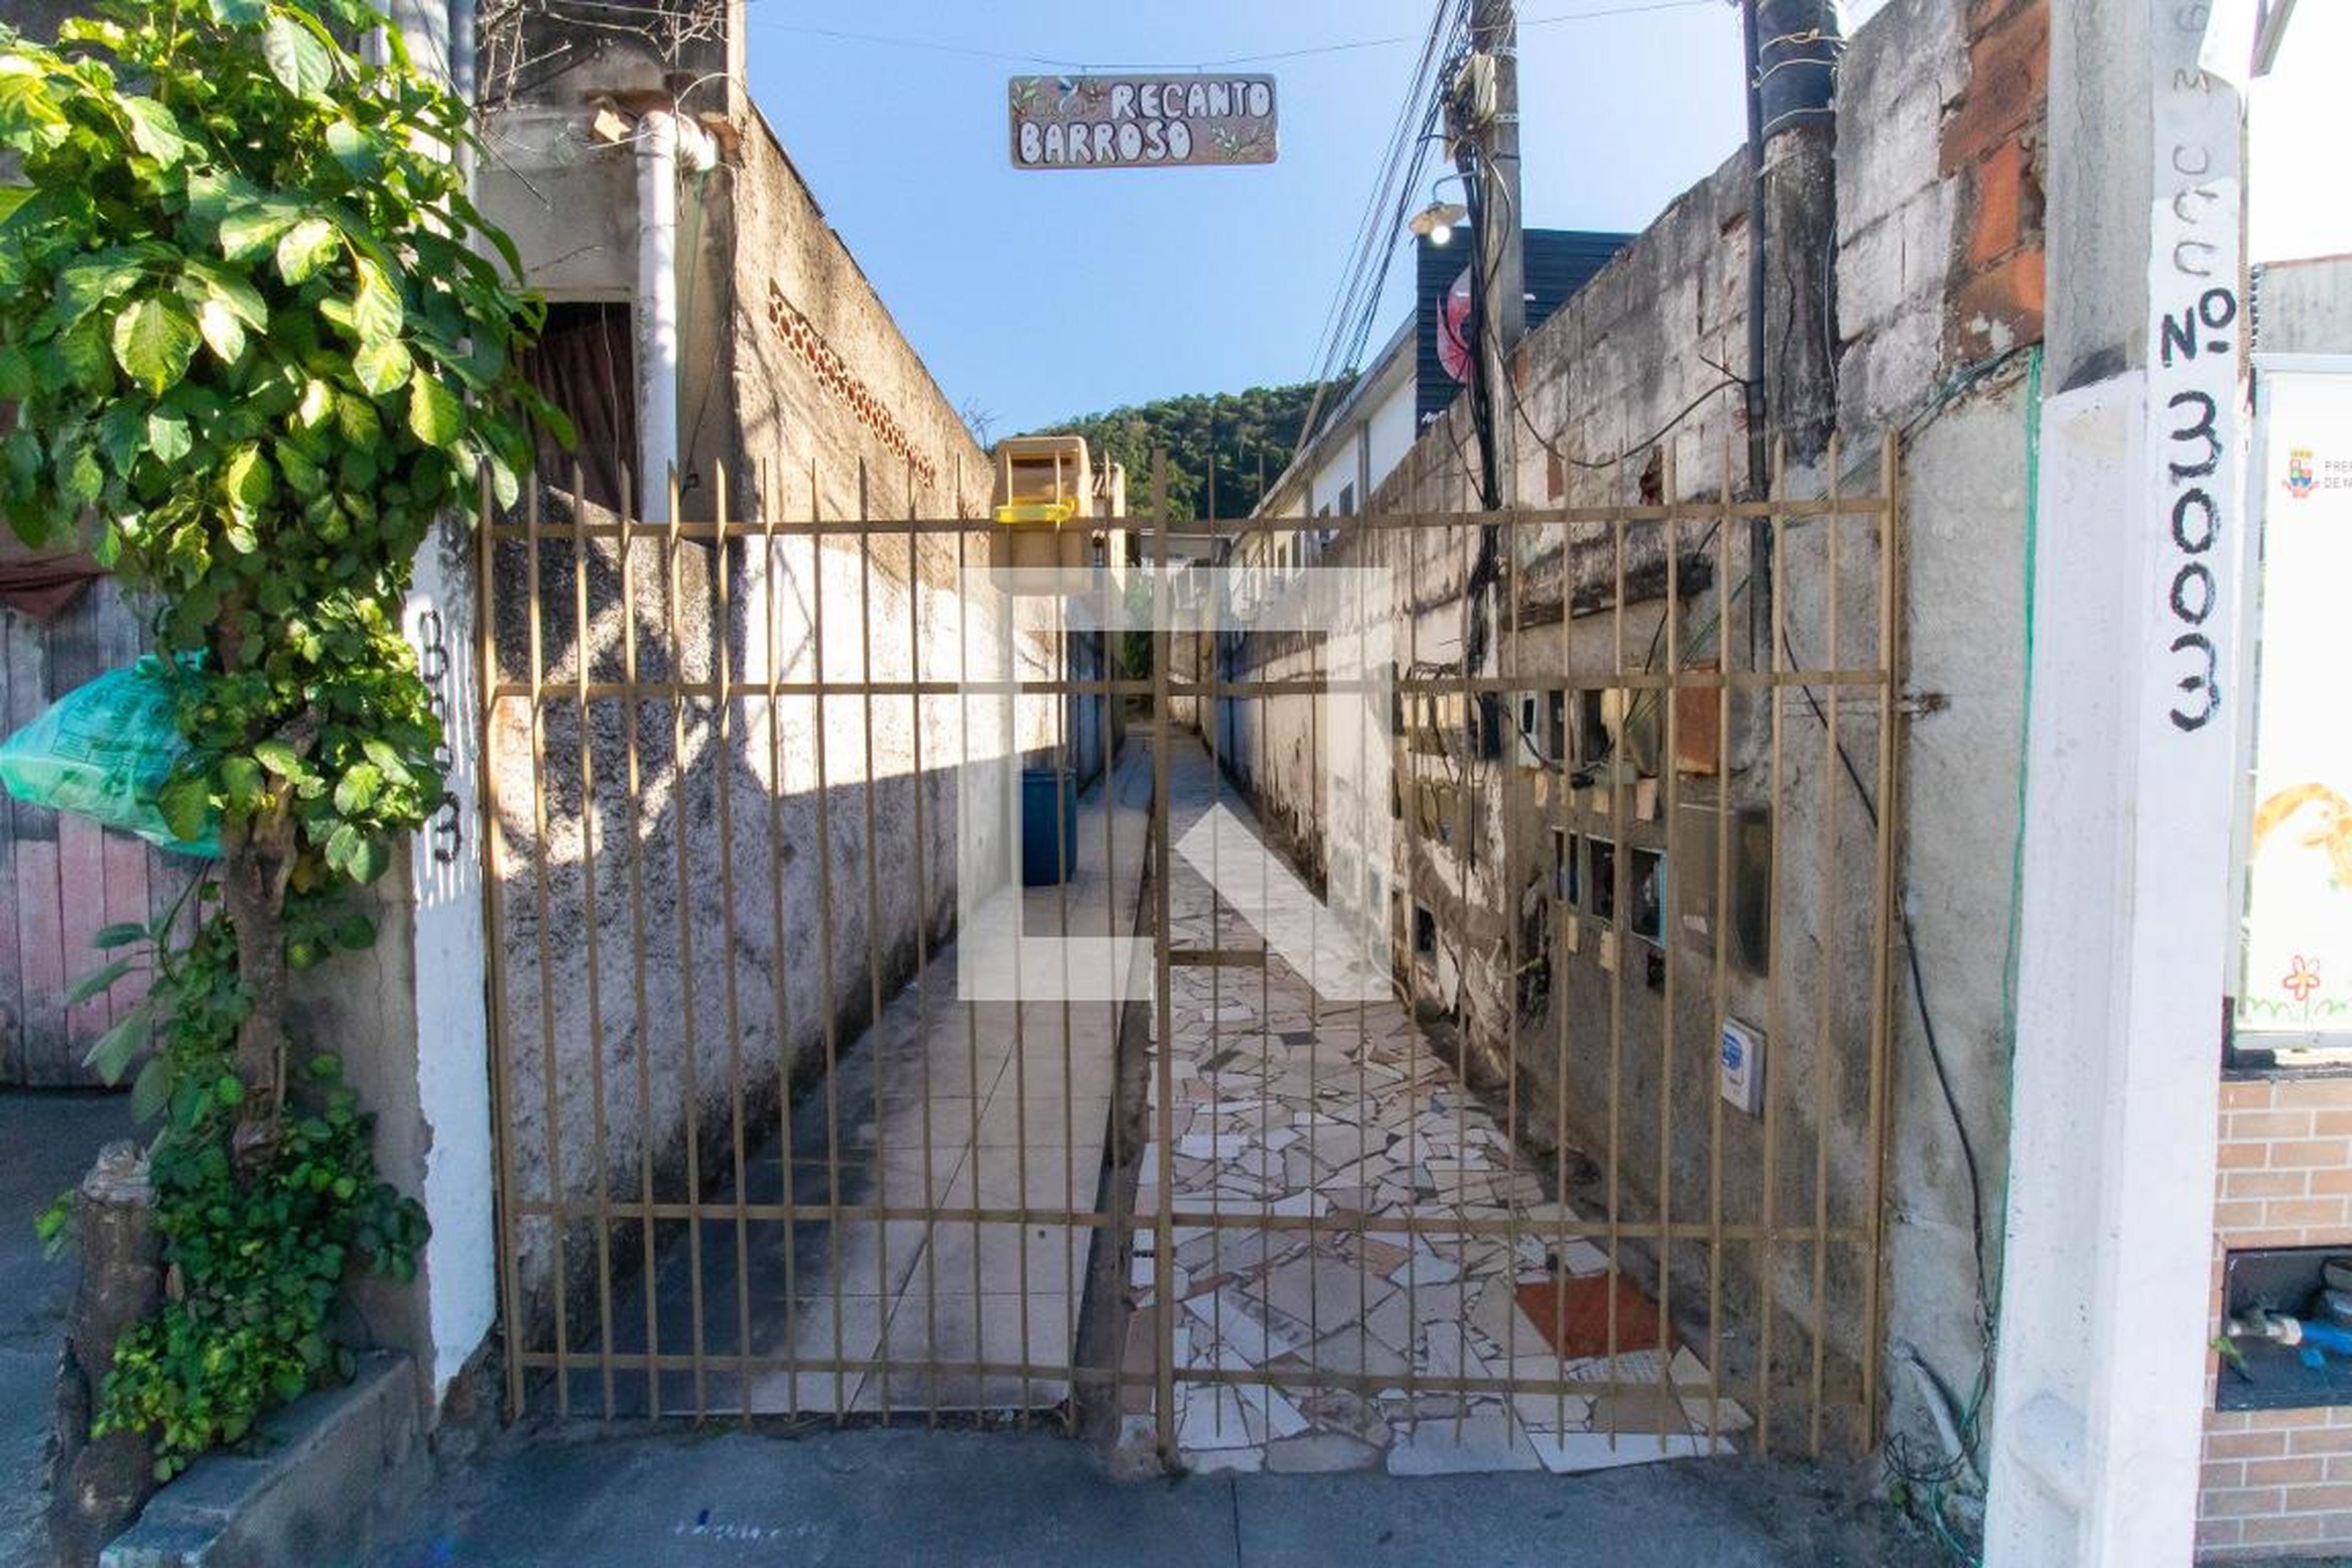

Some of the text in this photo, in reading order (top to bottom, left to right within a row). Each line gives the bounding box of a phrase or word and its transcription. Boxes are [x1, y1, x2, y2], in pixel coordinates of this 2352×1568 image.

[1111, 80, 1272, 119] RECANTO
[1019, 121, 1193, 164] BARROSO
[2168, 390, 2223, 732] 3003
